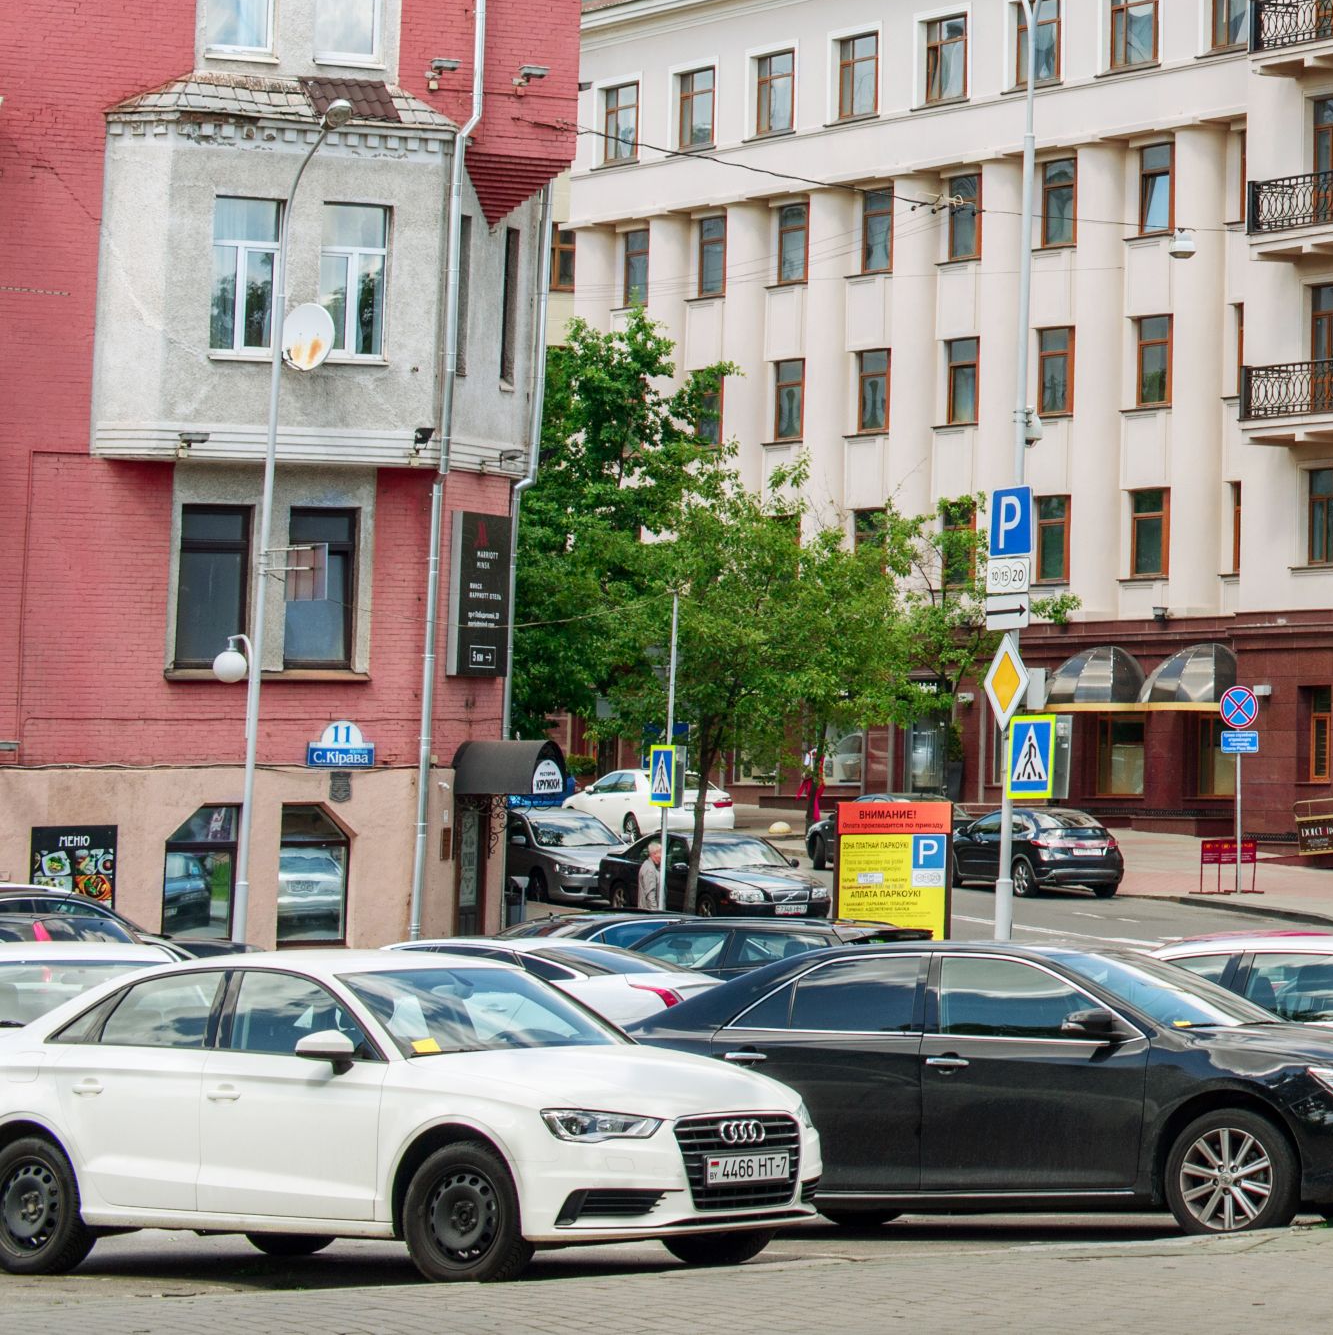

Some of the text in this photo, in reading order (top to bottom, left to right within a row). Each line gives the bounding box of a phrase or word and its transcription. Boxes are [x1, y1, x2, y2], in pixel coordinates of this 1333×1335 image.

[999, 495, 1022, 549] P
[991, 569, 1024, 582] 10 15 20
[472, 650, 478, 663] 5
[332, 725, 351, 745] 11
[859, 810, 917, 820] ВНИМАНИЕ!
[58, 835, 91, 847] МЕНЮ
[919, 839, 939, 865] P
[850, 890, 878, 898] АПЛАТА
[722, 1156, 787, 1180] 4466 HT-7
[709, 1172, 718, 1180] BY
